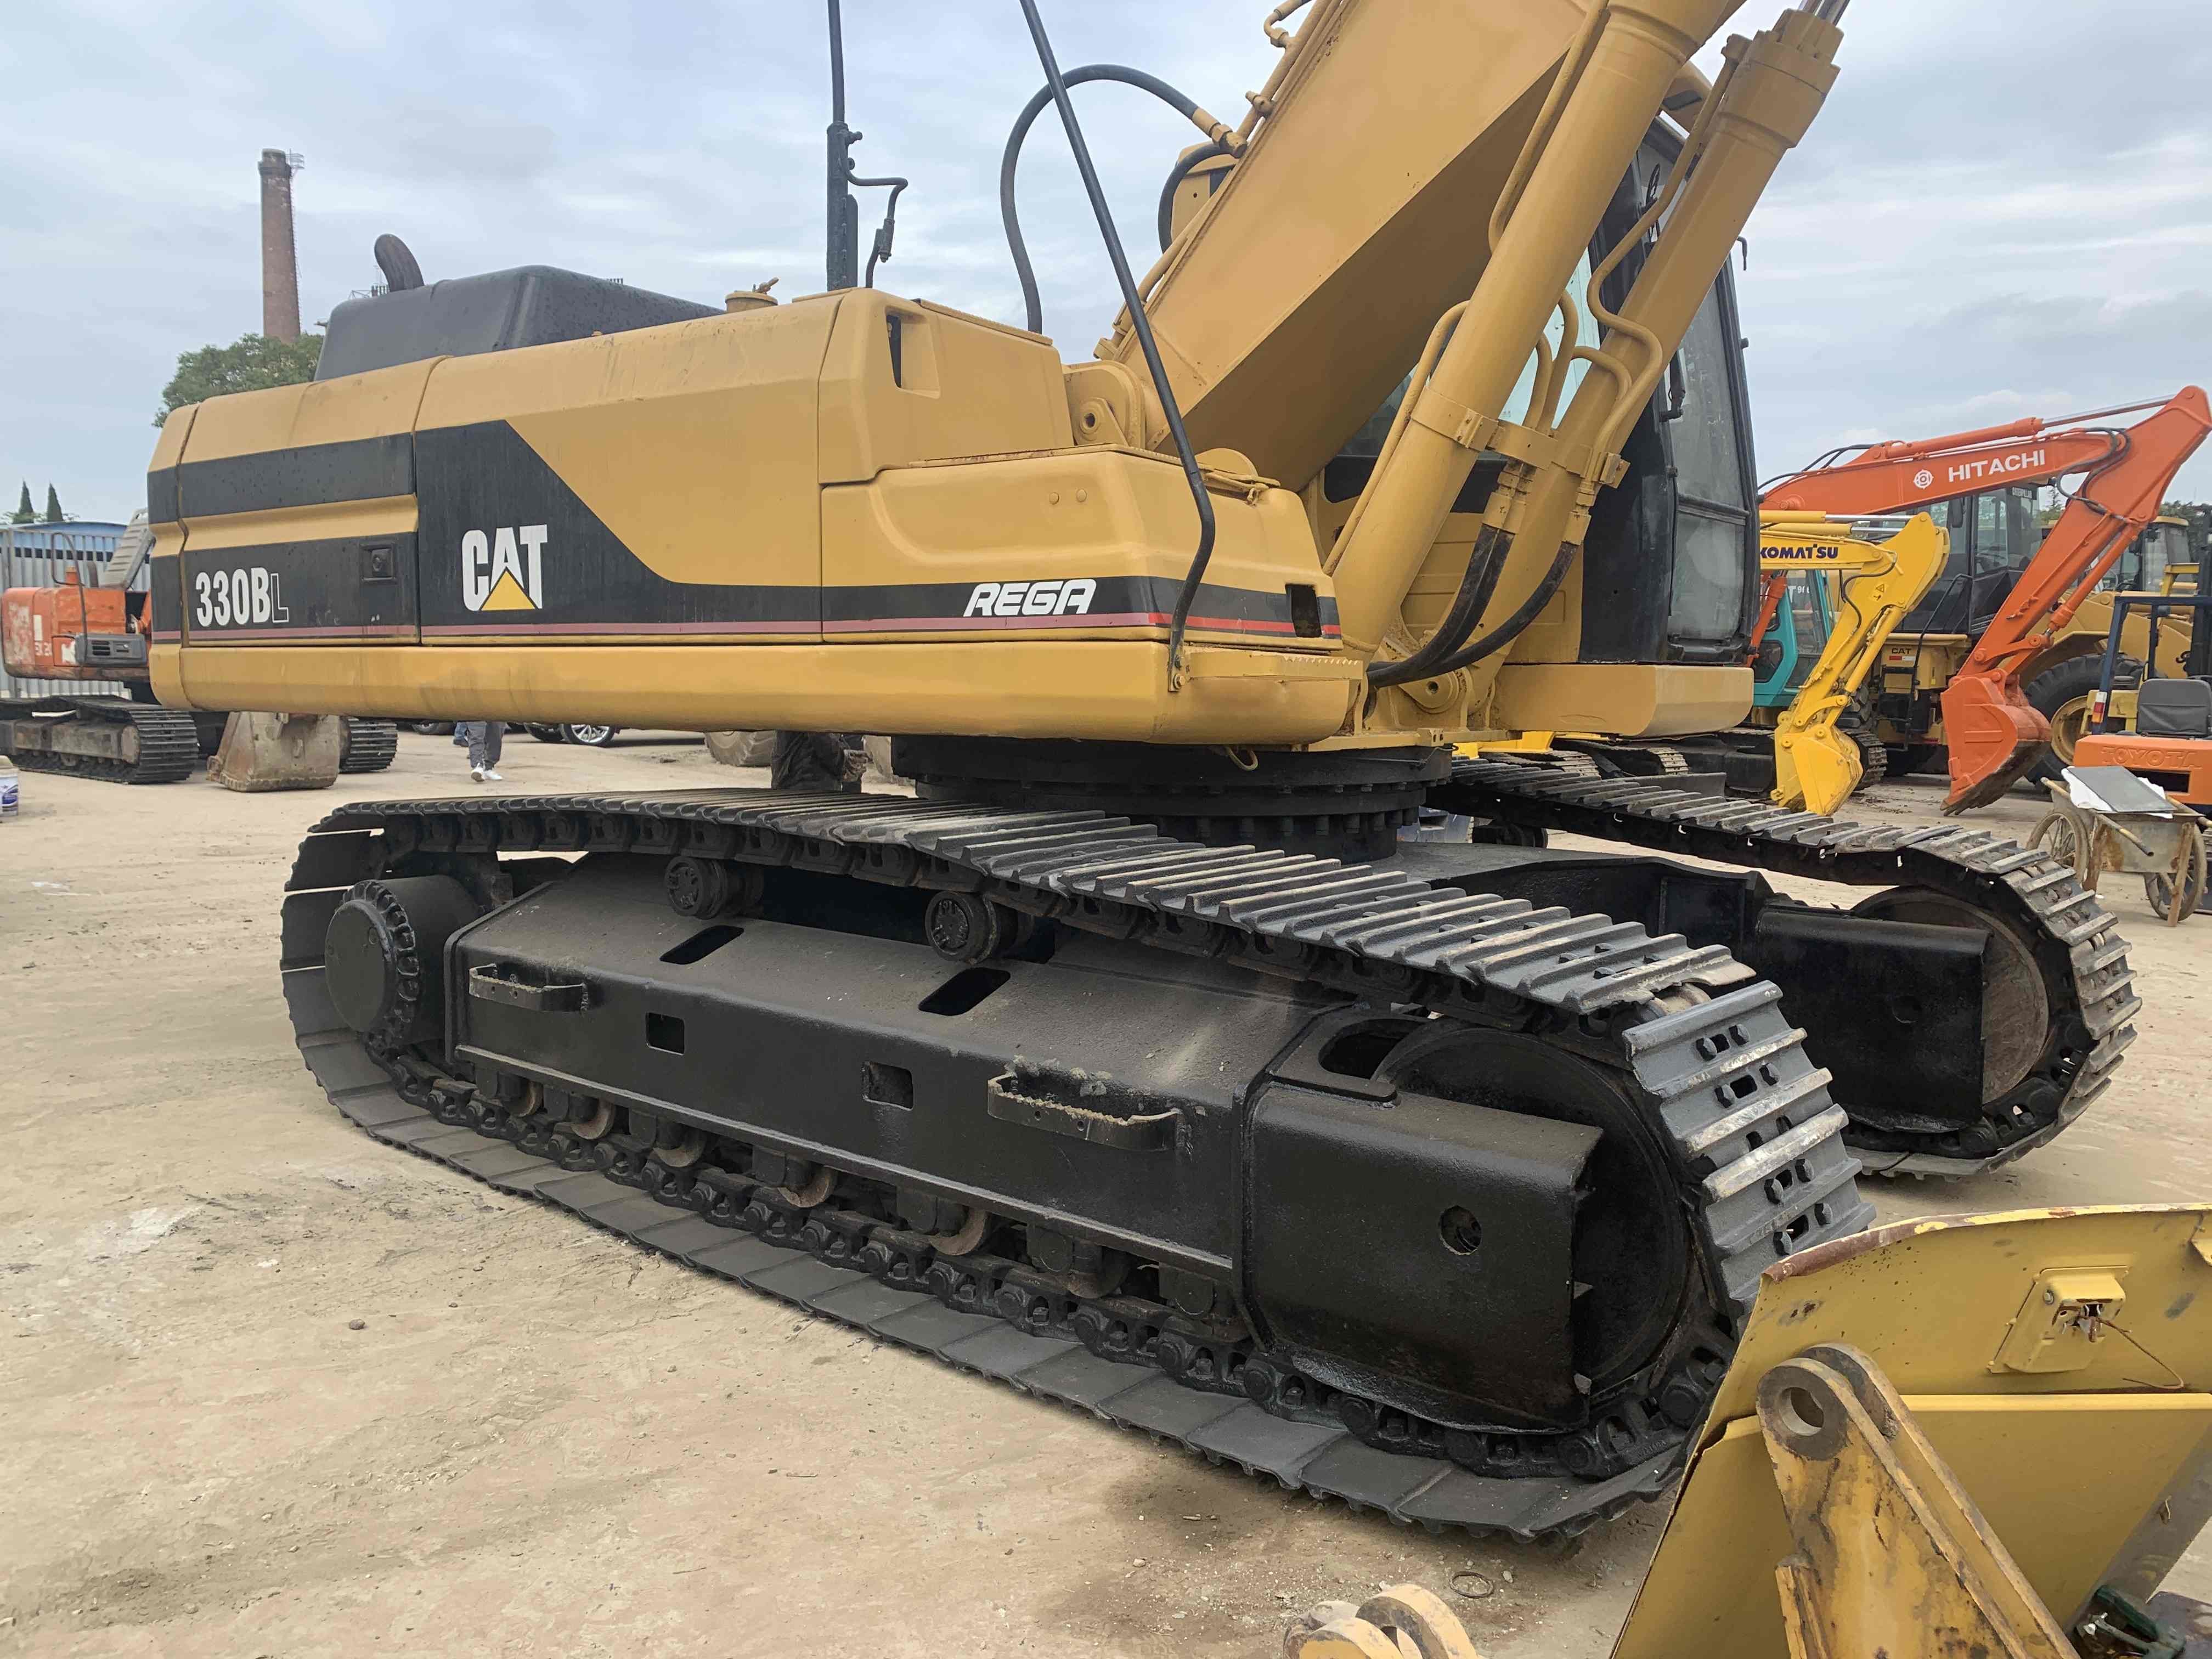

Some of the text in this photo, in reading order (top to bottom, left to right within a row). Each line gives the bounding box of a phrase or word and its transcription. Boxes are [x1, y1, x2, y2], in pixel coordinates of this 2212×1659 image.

[1948, 449, 2046, 482] HITACHI
[461, 524, 548, 612] CAT
[963, 579, 1097, 617] REGA
[2101, 747, 2203, 769] TOYOTA
